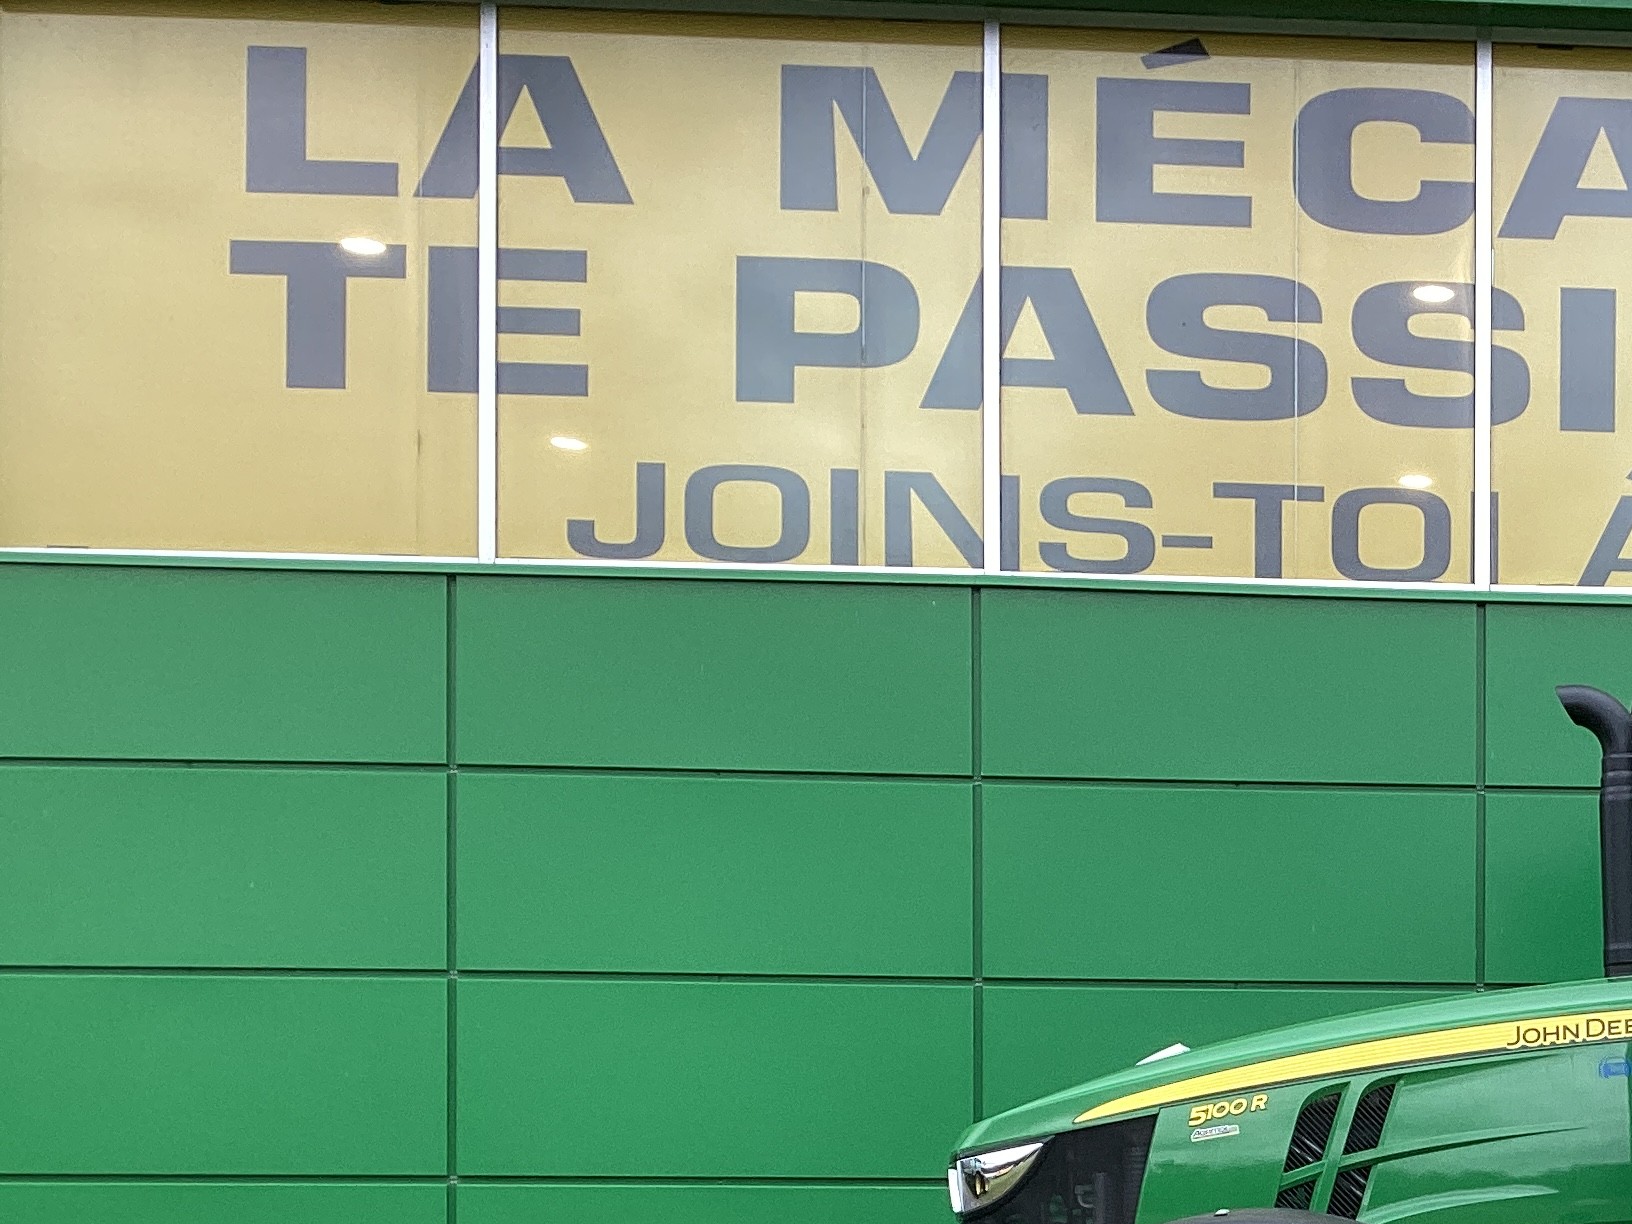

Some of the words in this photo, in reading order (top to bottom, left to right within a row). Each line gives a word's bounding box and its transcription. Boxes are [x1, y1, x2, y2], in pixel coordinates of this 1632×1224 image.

[246, 45, 635, 205] LA
[230, 239, 589, 397] TE
[1507, 1024, 1580, 1046] JOHN
